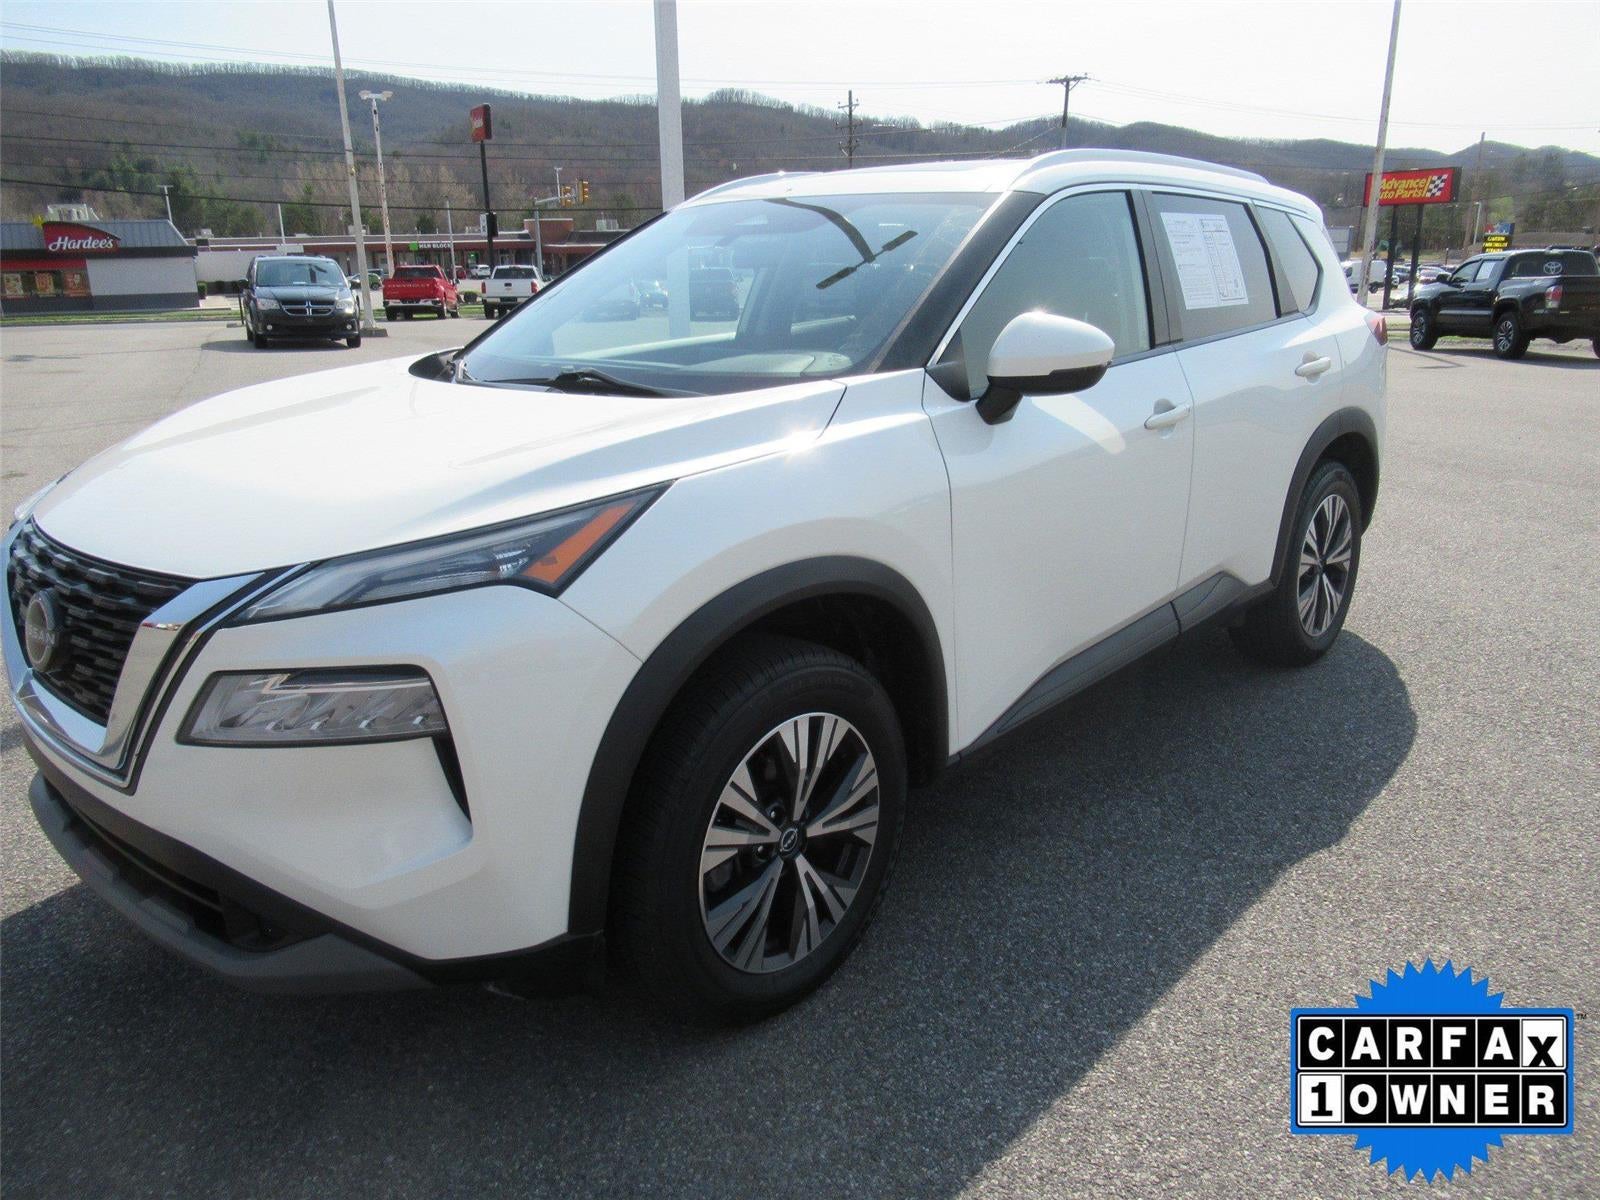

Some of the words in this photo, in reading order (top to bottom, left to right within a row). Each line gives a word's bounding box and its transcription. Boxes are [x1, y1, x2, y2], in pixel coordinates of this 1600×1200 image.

[1380, 177, 1427, 190] Advance
[1379, 190, 1394, 199] uto
[1395, 188, 1423, 198] Parts
[49, 236, 113, 251] Hardee's
